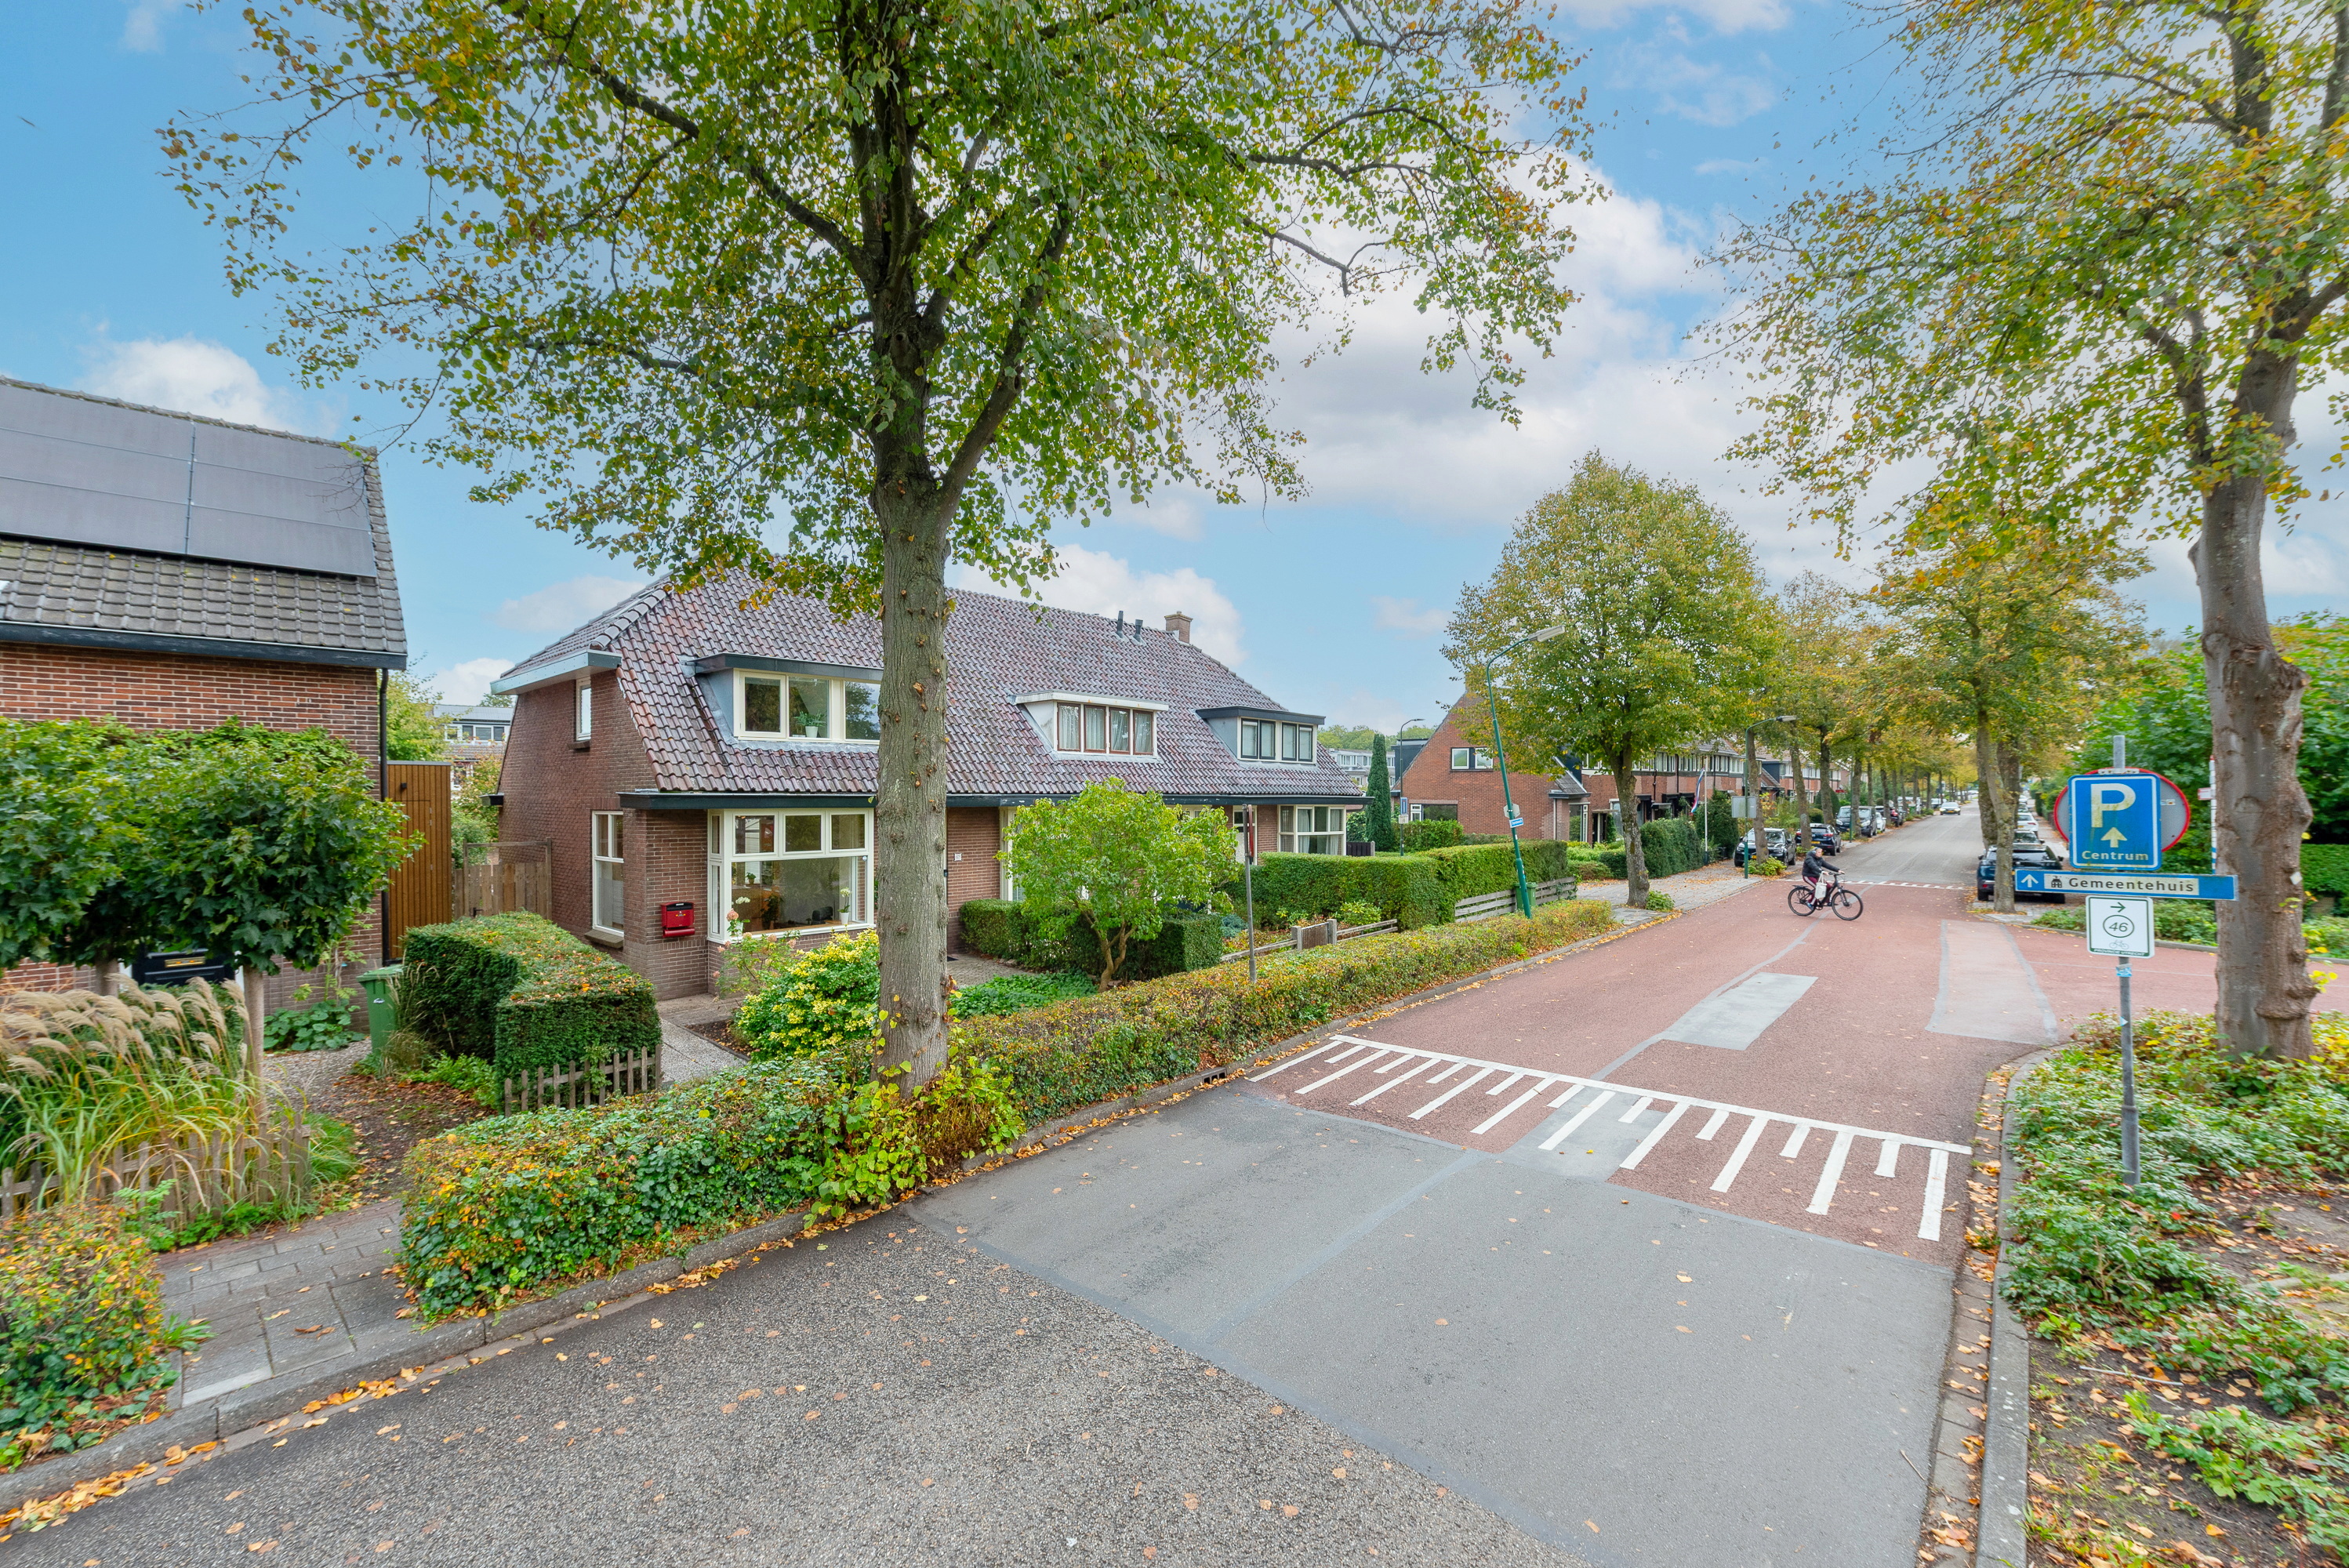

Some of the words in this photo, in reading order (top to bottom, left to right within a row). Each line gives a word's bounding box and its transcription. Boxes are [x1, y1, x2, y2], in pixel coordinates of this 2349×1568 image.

[2090, 783, 2136, 827] P
[2082, 851, 2148, 860] Centrum
[2069, 877, 2194, 892] Gemeentehuis
[2108, 922, 2129, 932] 46
